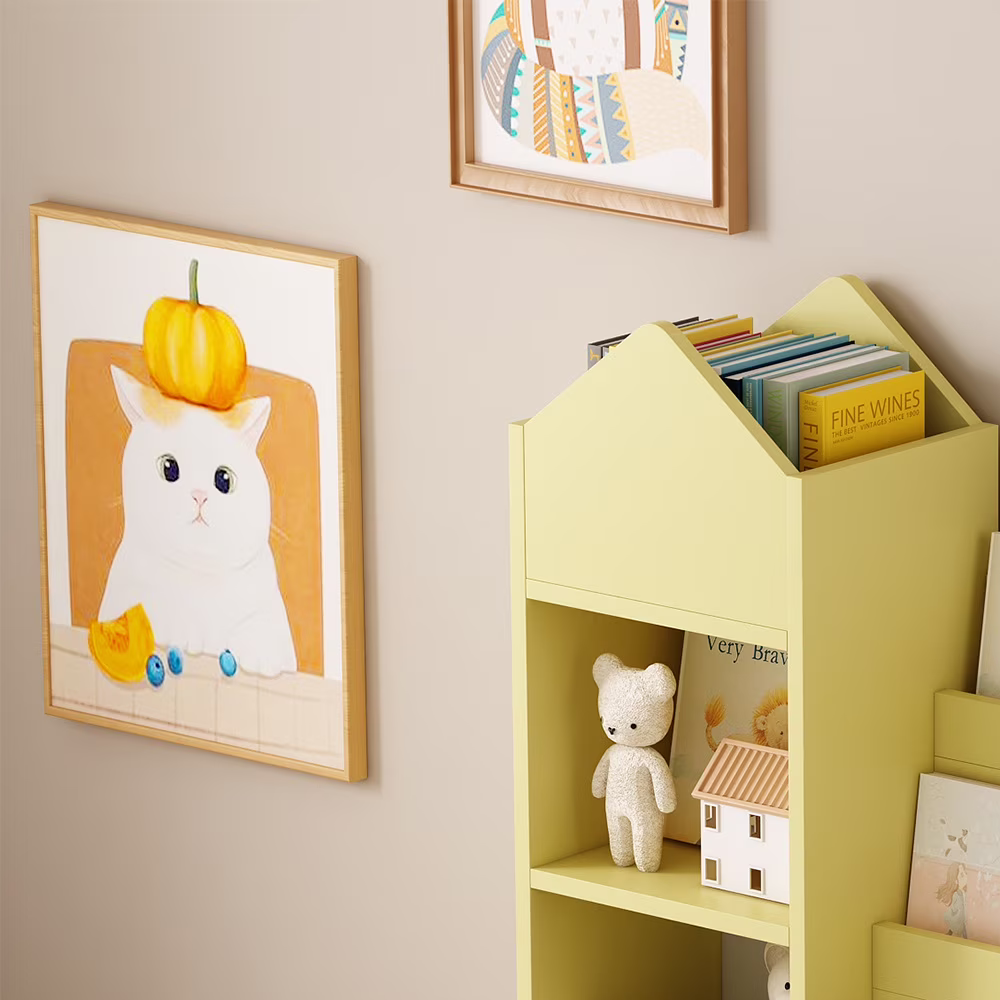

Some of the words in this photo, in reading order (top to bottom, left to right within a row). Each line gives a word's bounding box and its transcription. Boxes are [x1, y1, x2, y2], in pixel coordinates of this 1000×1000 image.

[832, 404, 865, 430] FINE
[870, 389, 920, 418] WINES
[832, 430, 842, 438] THE
[844, 426, 857, 435] BEST
[860, 418, 887, 431] VINTAGES
[888, 414, 904, 423] SINCE
[906, 409, 920, 418] 1900
[707, 635, 744, 663] Very
[752, 645, 788, 665] Brav
